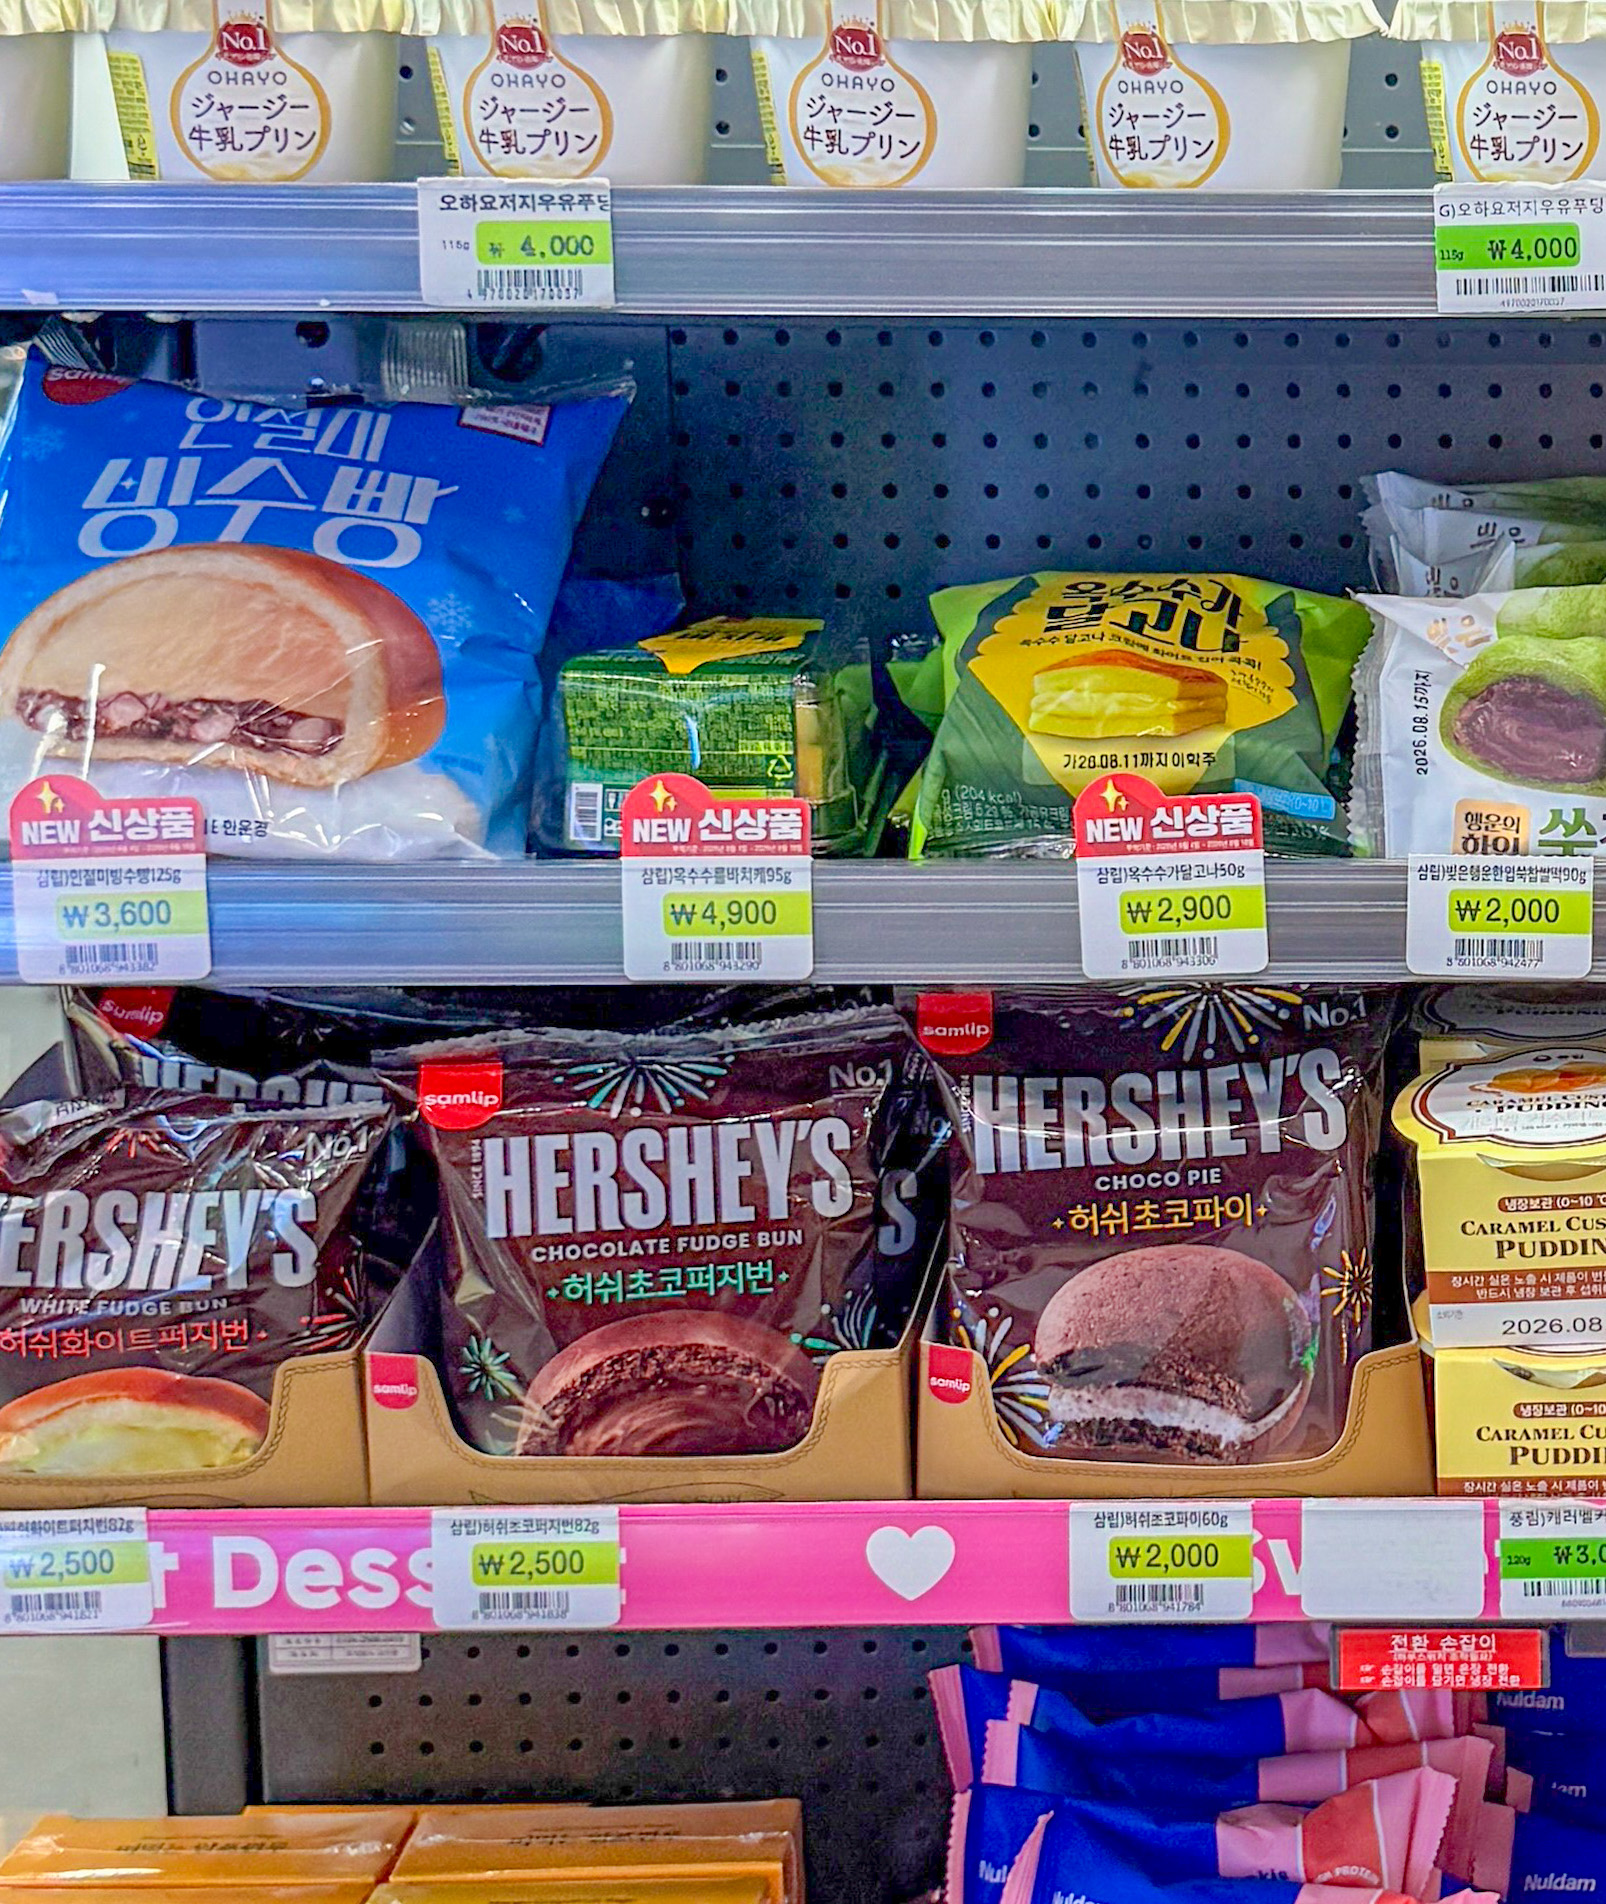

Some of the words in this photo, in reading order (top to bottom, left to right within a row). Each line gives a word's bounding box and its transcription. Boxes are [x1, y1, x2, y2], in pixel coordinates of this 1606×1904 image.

[207, 71, 288, 86] OHAYO
[1486, 80, 1557, 96] OHAYO
[191, 95, 310, 120] ジャージー
[1473, 104, 1578, 128] ジャージー
[188, 127, 316, 154] 牛乳プリン
[1469, 135, 1584, 163] 牛乳プリン
[78, 455, 458, 568] 빙수빵
[22, 819, 79, 844] NEW
[87, 809, 195, 841] 신상품
[1087, 817, 1143, 843] NEW
[1150, 801, 1255, 837] 신상품
[923, 1022, 991, 1039] samlip
[424, 1091, 499, 1107] samlip
[974, 1048, 1348, 1175] HERSHEY'S
[484, 1117, 855, 1239] HERSHEY'S
[1095, 1170, 1182, 1192] CHOCO
[1188, 1168, 1222, 1185] PIE
[1069, 1192, 1254, 1237] 허쉬초코파이
[0, 1189, 319, 1291] ERSHEY'S
[1461, 1220, 1560, 1236] CARAMEL
[531, 1237, 670, 1263] CHOCOLATE
[678, 1231, 752, 1251] FUDGE
[758, 1229, 804, 1248] BUN
[562, 1259, 775, 1304] 허쉬초코퍼지번
[20, 1298, 91, 1317] WHITE
[97, 1299, 174, 1317] FUDGE
[180, 1297, 228, 1314] BUN
[1390, 1634, 1429, 1652] 전환
[1441, 1633, 1496, 1651] 손잡이
[1524, 1873, 1596, 1892] Nuldam
